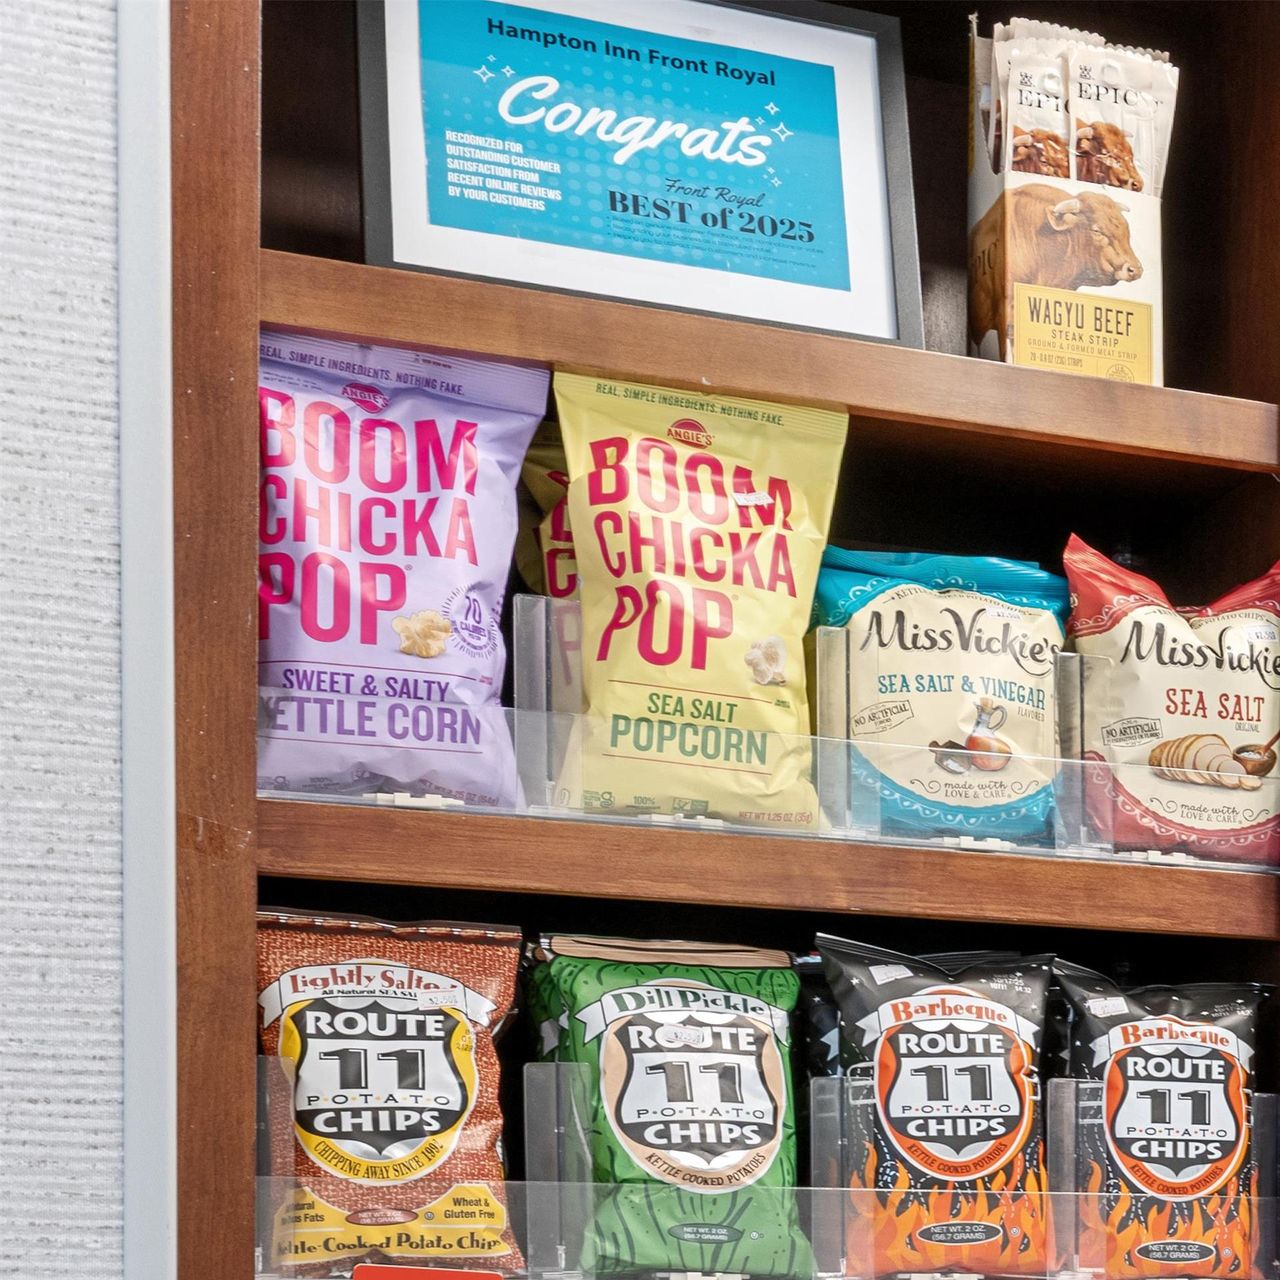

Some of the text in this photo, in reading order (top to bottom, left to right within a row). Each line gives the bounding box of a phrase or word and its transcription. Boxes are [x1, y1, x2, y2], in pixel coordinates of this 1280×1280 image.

[487, 17, 776, 87] Hampton Inn Front Royal
[498, 76, 772, 167] Congrats
[445, 131, 523, 153] RECOGNIZED FOR
[446, 144, 561, 174] OUTSTANDING CUSTOMER
[447, 158, 540, 183] SATISFACTION FROM
[447, 172, 562, 200] RECENT ONLINE REVIEWS
[448, 185, 546, 211] BY YOUR CUSTOMERS
[665, 177, 766, 209] Front Royal
[608, 190, 692, 223] BEST
[701, 207, 733, 230] of
[739, 211, 814, 243] 2025
[1027, 296, 1134, 337] WAGYU BEEF
[289, 350, 465, 396] SIMPLE INGREDIENTS. NOTHING FAKE.
[259, 386, 478, 496] BOOM
[259, 473, 478, 567] CHICKA
[594, 510, 797, 598] CHICKA
[259, 552, 407, 645] POP
[597, 580, 733, 670] POP
[283, 669, 449, 701] SWEET SALTY
[878, 674, 1046, 710] SEA SALT VINEGAR
[647, 692, 738, 723] SEA SALT
[1165, 688, 1265, 722] SEA SALT
[387, 704, 480, 745] CORN
[610, 714, 768, 766] POPCORN
[289, 966, 376, 994] Lightly
[611, 987, 765, 1016] Dill Pickle
[891, 999, 1008, 1023] Barbeque
[305, 1011, 445, 1039] ROUTE
[900, 1034, 1004, 1054] ROUTE
[318, 1048, 426, 1091] 11
[313, 1109, 441, 1133] CHIPS
[643, 1123, 762, 1146] CHIPS
[906, 1118, 1006, 1137] CHIPS
[363, 1156, 423, 1180] AWAY SINCE
[443, 1209, 477, 1219] Gluten
[452, 1197, 481, 1208] Wheat
